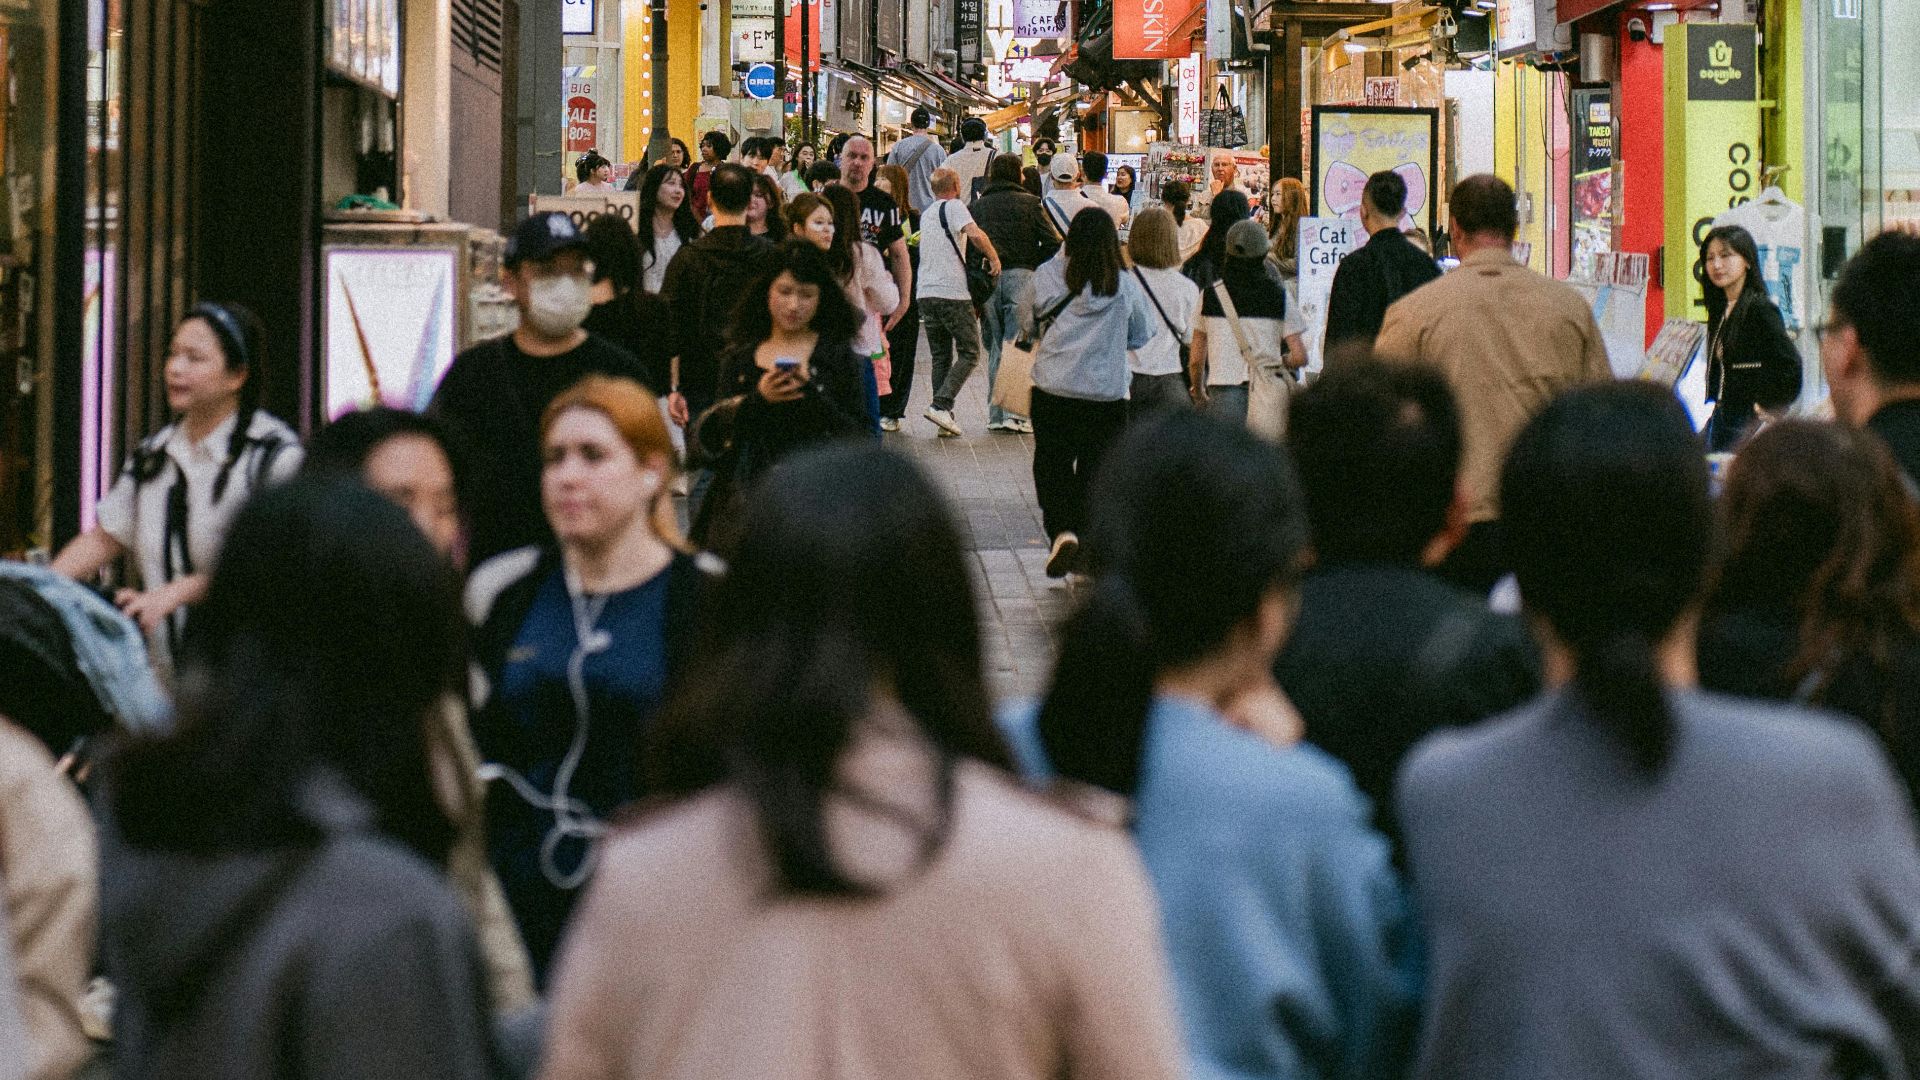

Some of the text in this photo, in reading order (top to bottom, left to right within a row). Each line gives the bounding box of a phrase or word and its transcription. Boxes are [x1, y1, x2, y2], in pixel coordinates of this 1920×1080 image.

[1142, 0, 1164, 52] SKIN
[570, 83, 591, 94] BIG
[568, 126, 592, 141] 80%
[1319, 226, 1347, 244] Cat
